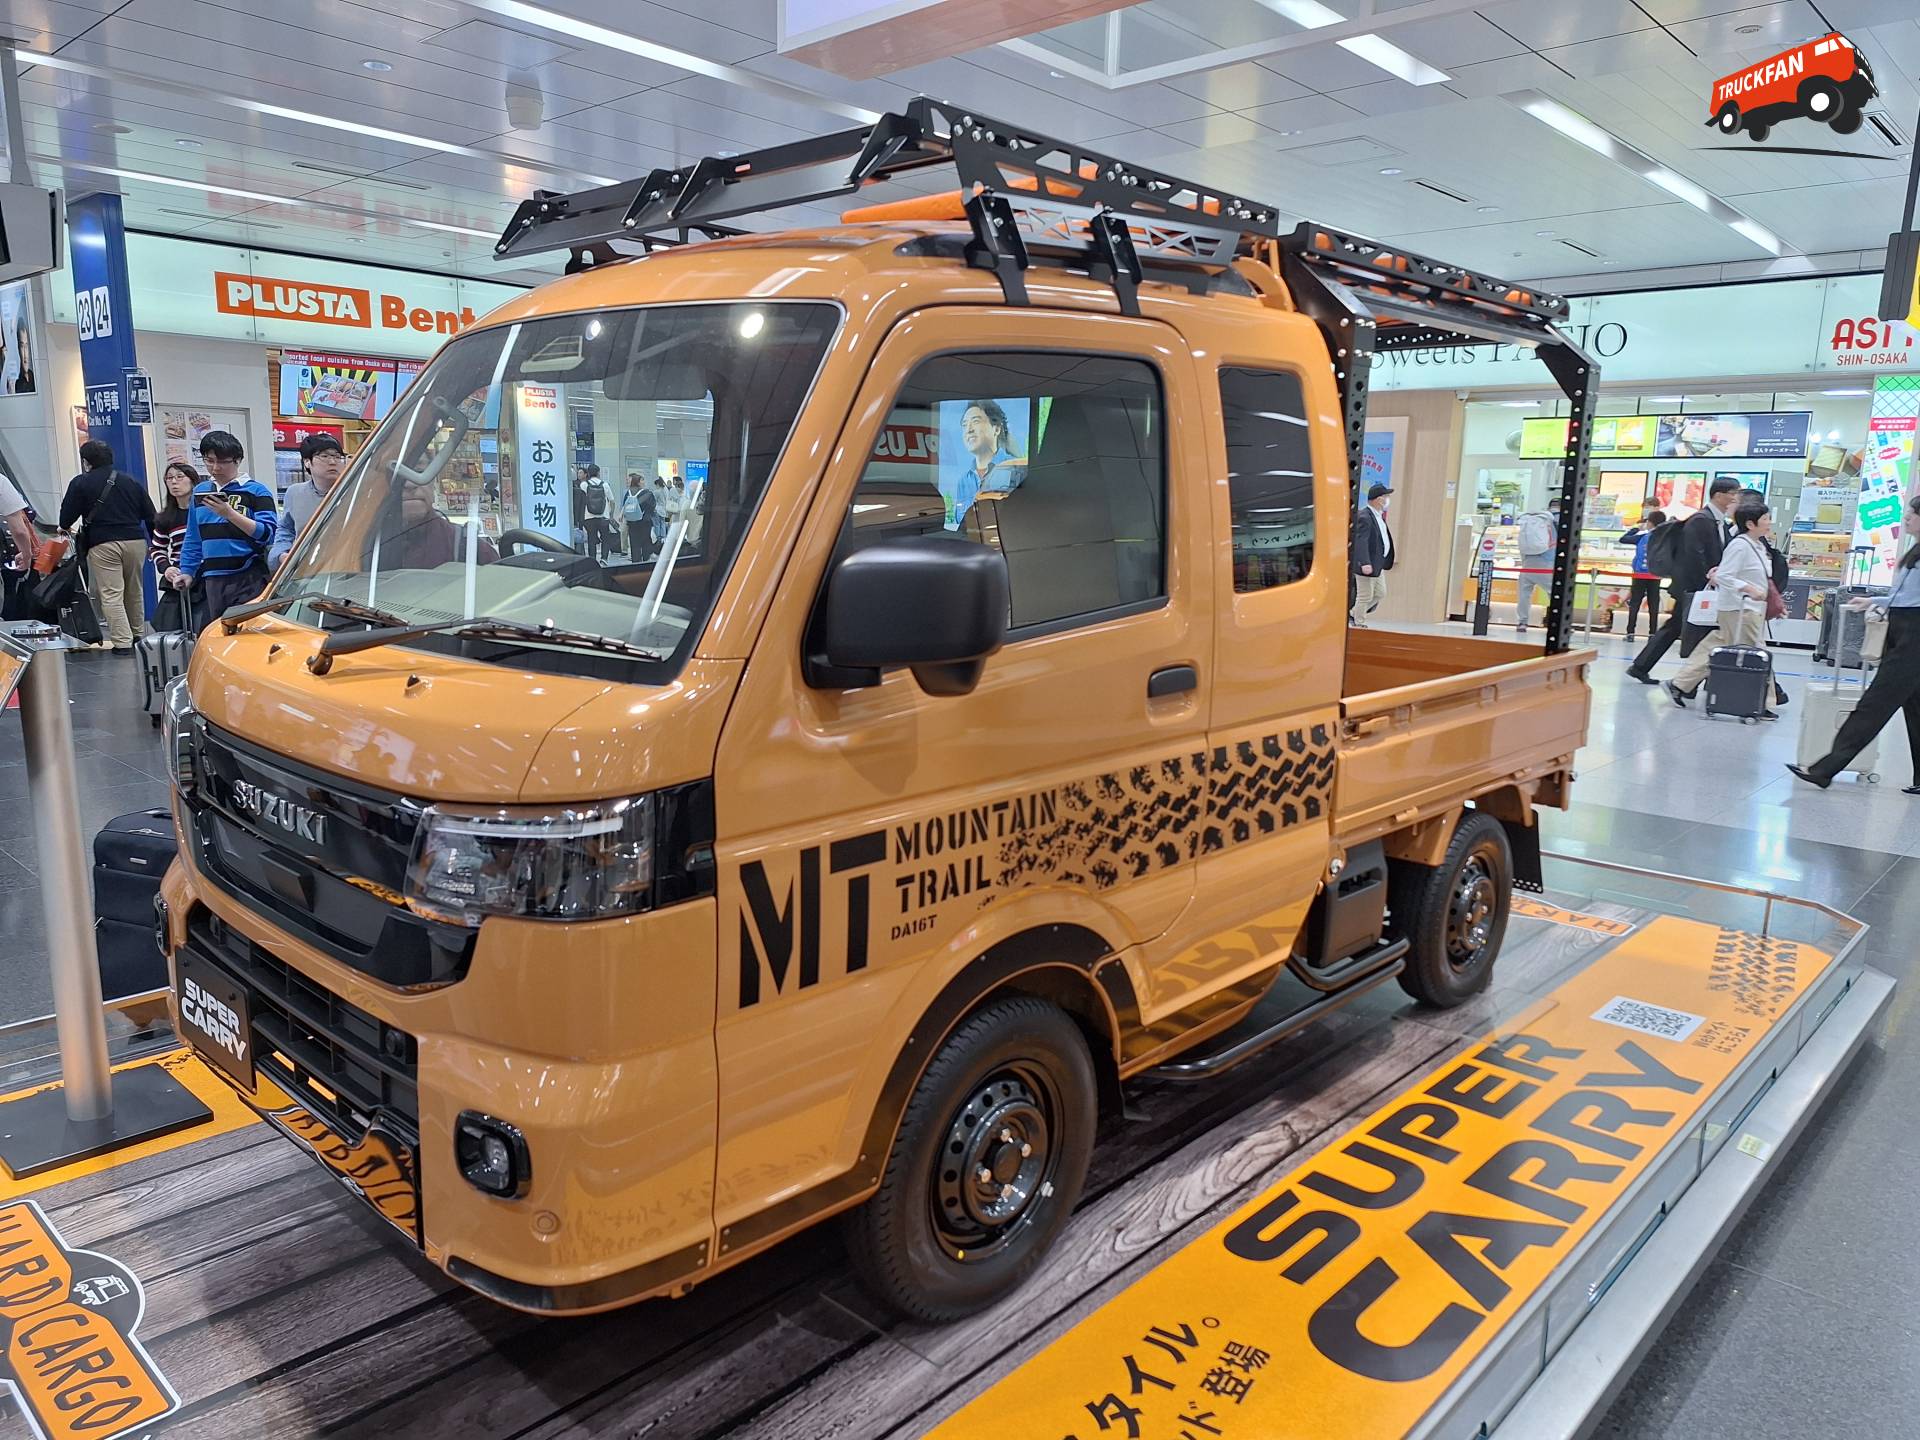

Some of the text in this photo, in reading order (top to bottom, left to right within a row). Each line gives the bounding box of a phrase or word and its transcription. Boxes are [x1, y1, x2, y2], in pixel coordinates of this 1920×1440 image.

[79, 294, 109, 334] 23 24
[227, 280, 360, 321] PLUSTA
[1837, 352, 1907, 366] SHIN-OSAKA
[525, 399, 557, 409] Bento
[532, 439, 557, 528] お飲物
[233, 779, 327, 845] SUZUKI
[739, 789, 1056, 1009] MT MOUNTAIN
[895, 855, 991, 914] TRAIL
[891, 914, 937, 940] DA16T
[181, 996, 247, 1062] CARRY
[184, 977, 240, 1035] SUPER
[1223, 1033, 1587, 1285] SUPER
[1307, 1039, 1705, 1382] CARRY
[17, 1313, 143, 1431] CARGO
[1063, 1316, 1220, 1440] タイル。
[1177, 1341, 1271, 1440] ド登場
